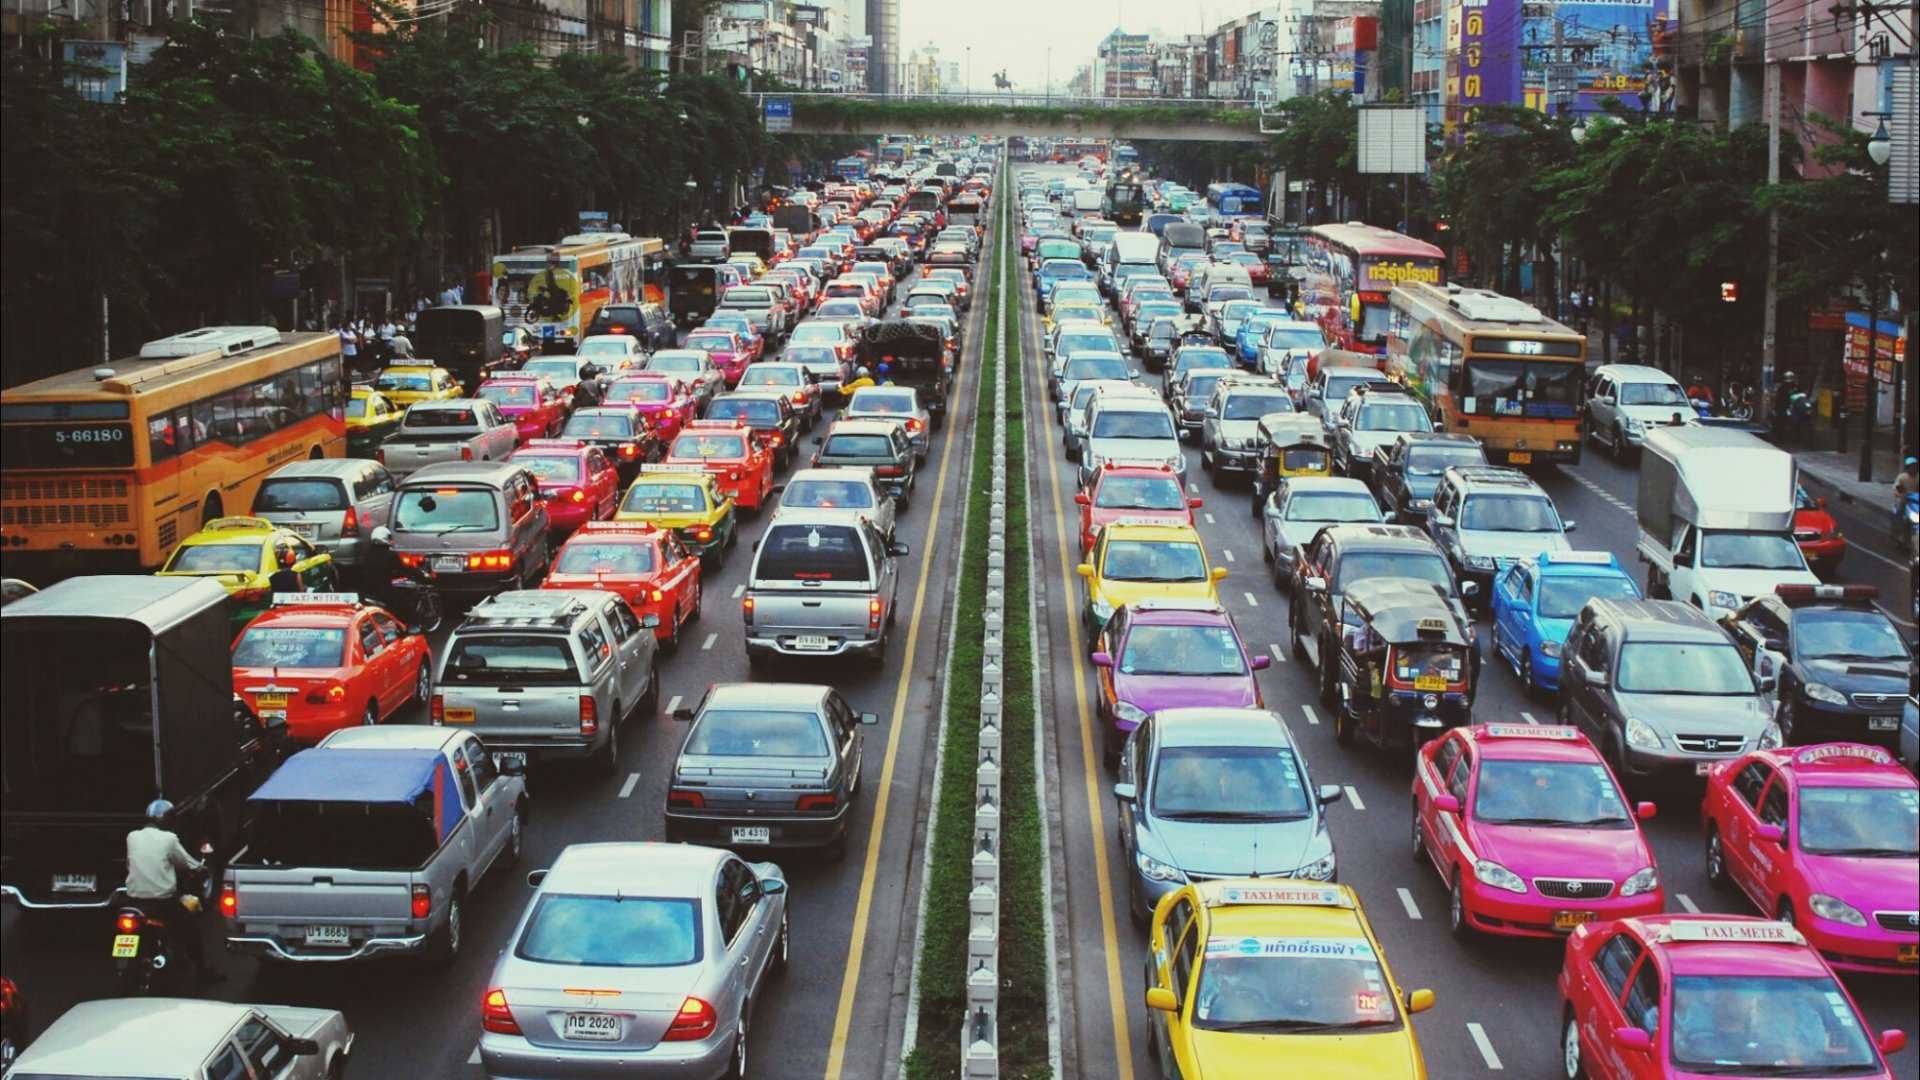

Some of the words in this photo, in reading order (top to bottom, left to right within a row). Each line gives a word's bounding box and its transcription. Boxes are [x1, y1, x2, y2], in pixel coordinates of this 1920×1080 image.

[55, 428, 123, 443] 5-66180
[1703, 926, 1785, 938] TAXI-METER
[589, 1017, 616, 1029] 2020
